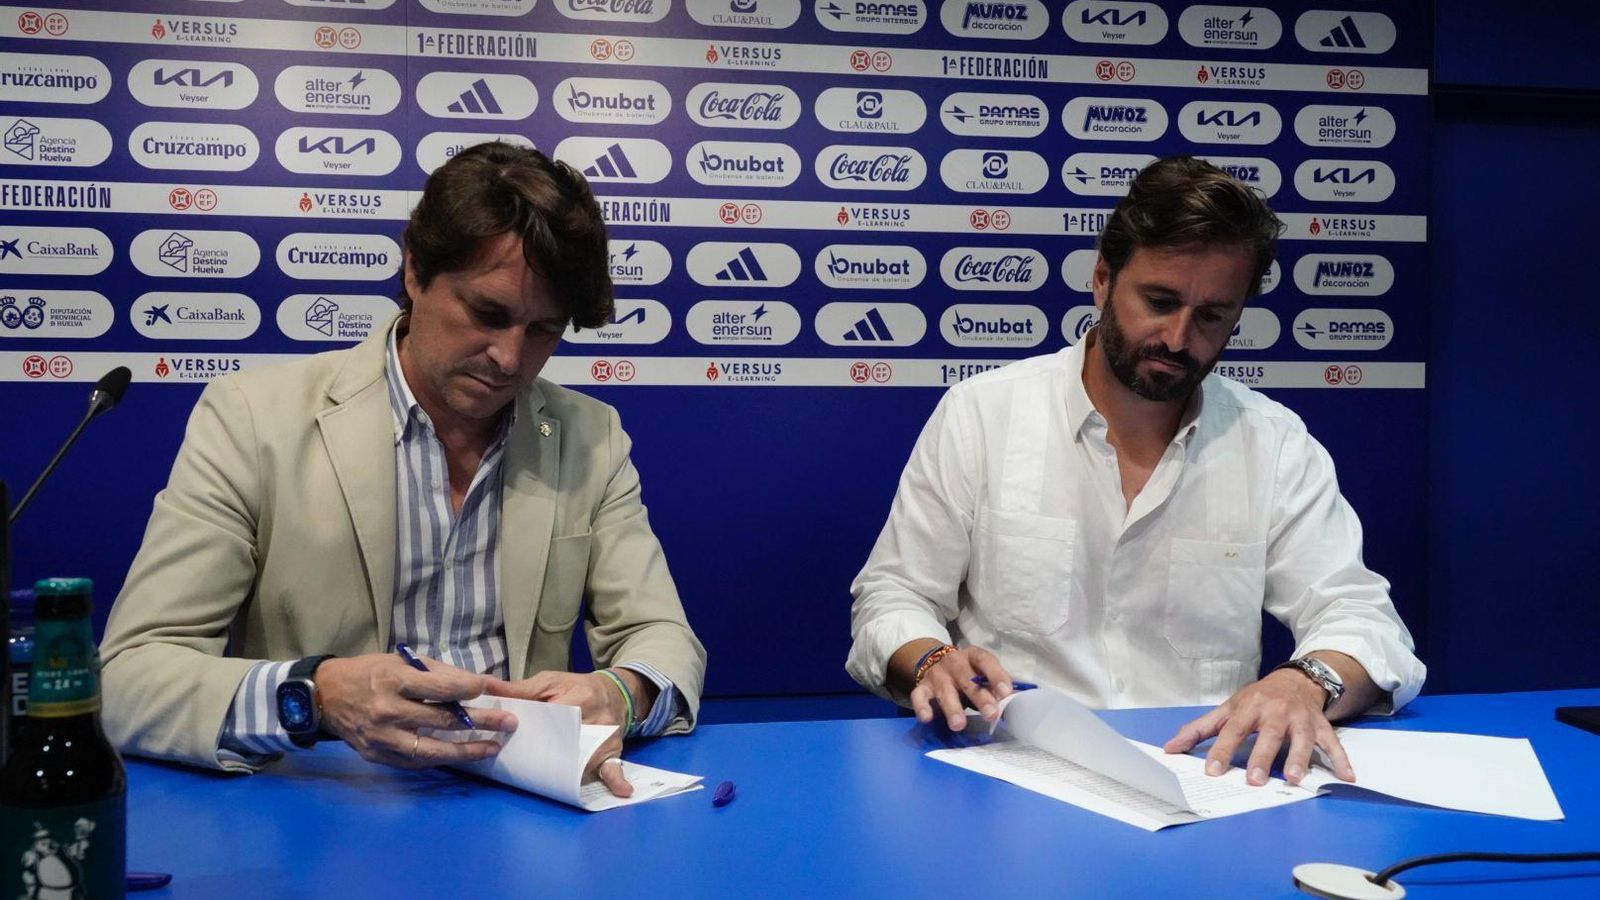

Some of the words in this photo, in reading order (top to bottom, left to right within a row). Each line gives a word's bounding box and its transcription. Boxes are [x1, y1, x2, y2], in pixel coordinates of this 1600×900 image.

[856, 3, 918, 16] DAMAS
[713, 15, 774, 25] CLAU&PAUL
[963, 2, 1028, 30] MUÑOZ
[168, 20, 236, 35] VERSUS
[1204, 17, 1234, 29] alter
[1102, 32, 1126, 40] Veyser
[1204, 30, 1257, 40] enersun
[438, 34, 536, 57] FEDERACIÓN
[720, 46, 781, 60] VERSUS
[960, 56, 1048, 78] FEDERACIÓN
[1210, 67, 1265, 79] VERSUS
[2, 73, 96, 91] ruzcampo
[306, 79, 342, 92] alter
[180, 94, 208, 103] Veyser
[306, 93, 370, 104] enersun
[576, 90, 655, 111] Onubat
[700, 91, 784, 121] Coca-Cola
[980, 106, 1040, 118] DAMAS
[1084, 106, 1147, 132] MUÑOZ
[1319, 116, 1348, 127] alter
[840, 121, 899, 130] CLAU&PAUL
[1218, 132, 1240, 140] Veyser
[1319, 128, 1371, 138] enersun
[40, 136, 76, 146] Agencia
[40, 145, 75, 154] Destino
[143, 136, 246, 159] Cruzcampo
[40, 153, 72, 162] Huelva
[705, 152, 784, 173] Onubat
[323, 161, 352, 170] Veyser
[830, 153, 912, 182] Coca-Cola
[966, 181, 1024, 190] CLAU&PAUL
[2, 184, 110, 208] FEDERACIÓN
[315, 194, 381, 207] VERSUS
[851, 208, 910, 220] VERSUS
[1322, 219, 1376, 230] VERSUS
[28, 242, 98, 256] CaixaBank
[193, 248, 228, 258] Agencia
[193, 257, 227, 265] Destino
[288, 246, 387, 268] Cruzcampo
[193, 266, 224, 274] Huelva
[834, 258, 910, 275] Onubat
[955, 255, 1034, 282] Coca-Cola
[1313, 262, 1374, 288] MUÑOZ
[177, 307, 245, 320] CaixaBank
[339, 312, 372, 322] Agencia
[713, 312, 746, 324] alter
[713, 326, 772, 335] enersun
[960, 317, 1032, 334] Onubat
[1330, 322, 1385, 333] DAMAS
[339, 329, 368, 338] Huelva
[597, 331, 622, 340] Veyser
[172, 359, 240, 371] VERSUS
[721, 364, 781, 374] VERSUS
